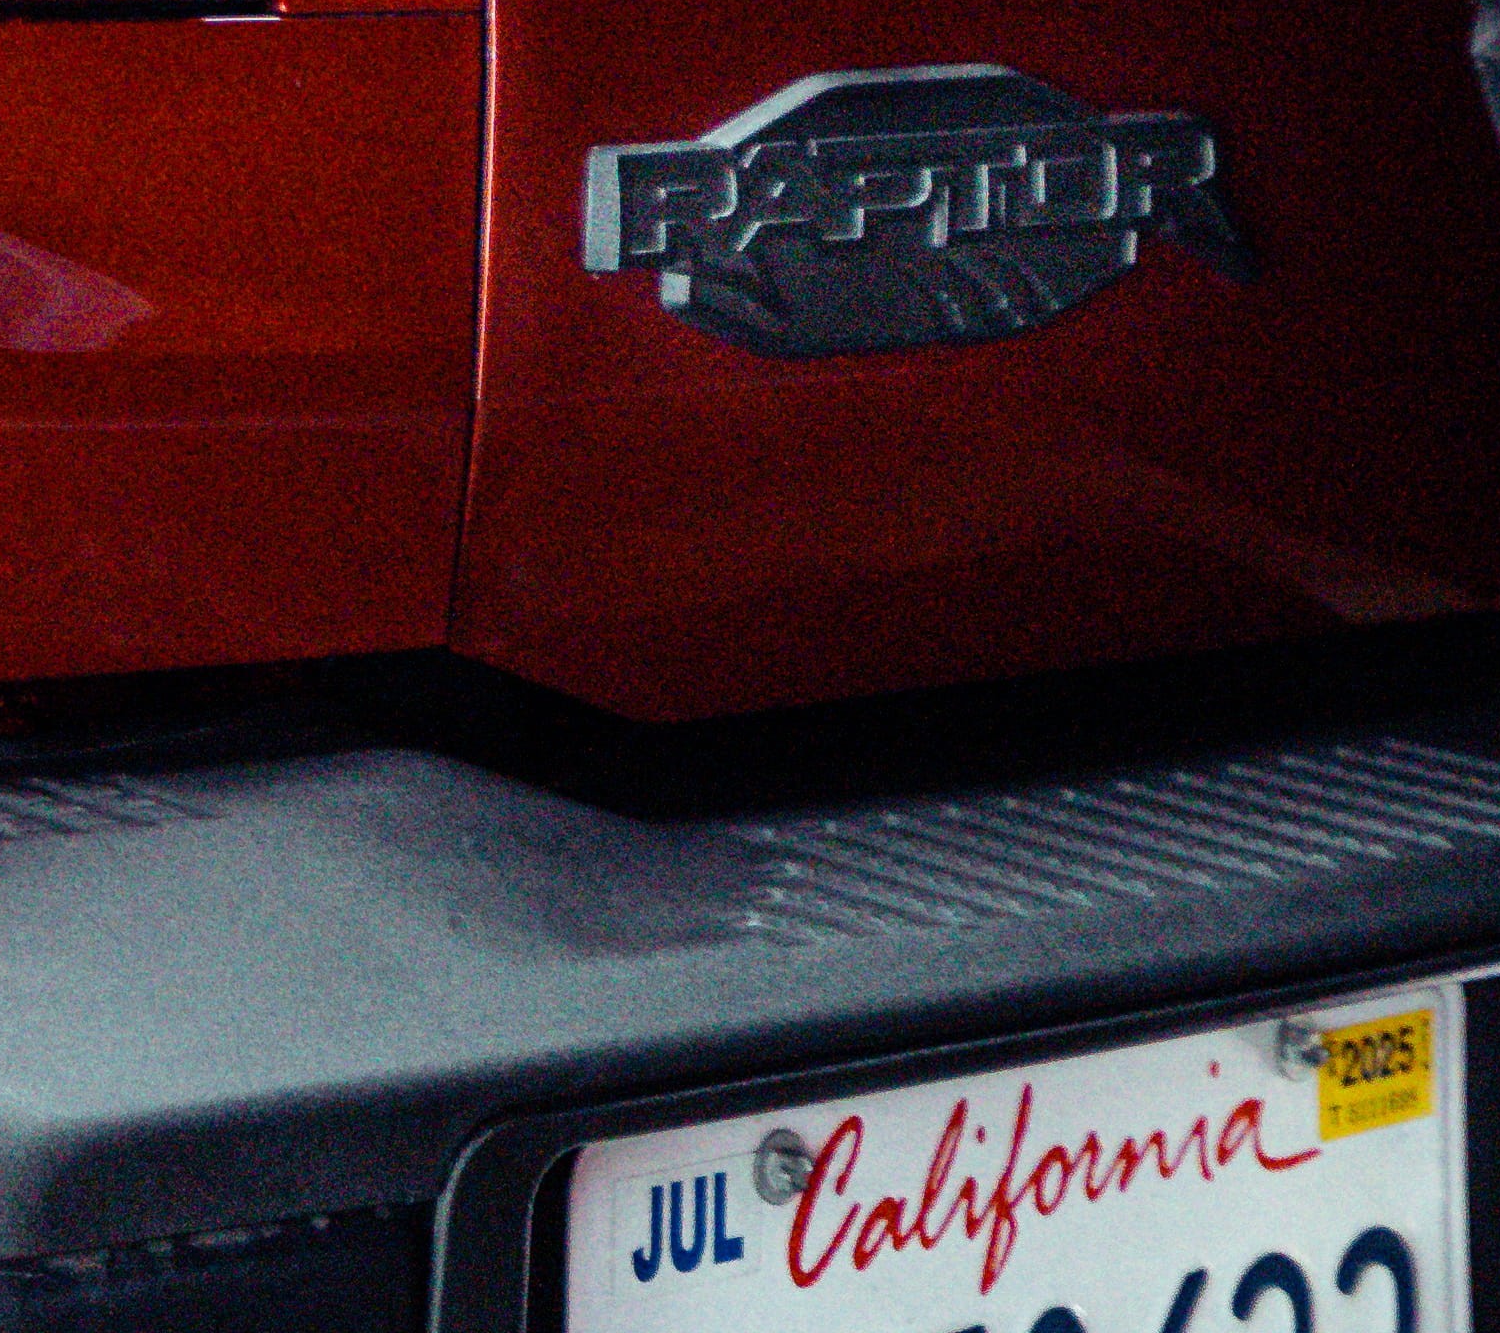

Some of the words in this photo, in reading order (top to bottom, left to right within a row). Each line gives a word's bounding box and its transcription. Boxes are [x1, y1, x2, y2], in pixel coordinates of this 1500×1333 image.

[584, 108, 1255, 308] RAPTOR
[1340, 1025, 1415, 1089] 2025
[632, 1172, 745, 1283] JUL
[787, 1060, 1322, 1296] California
